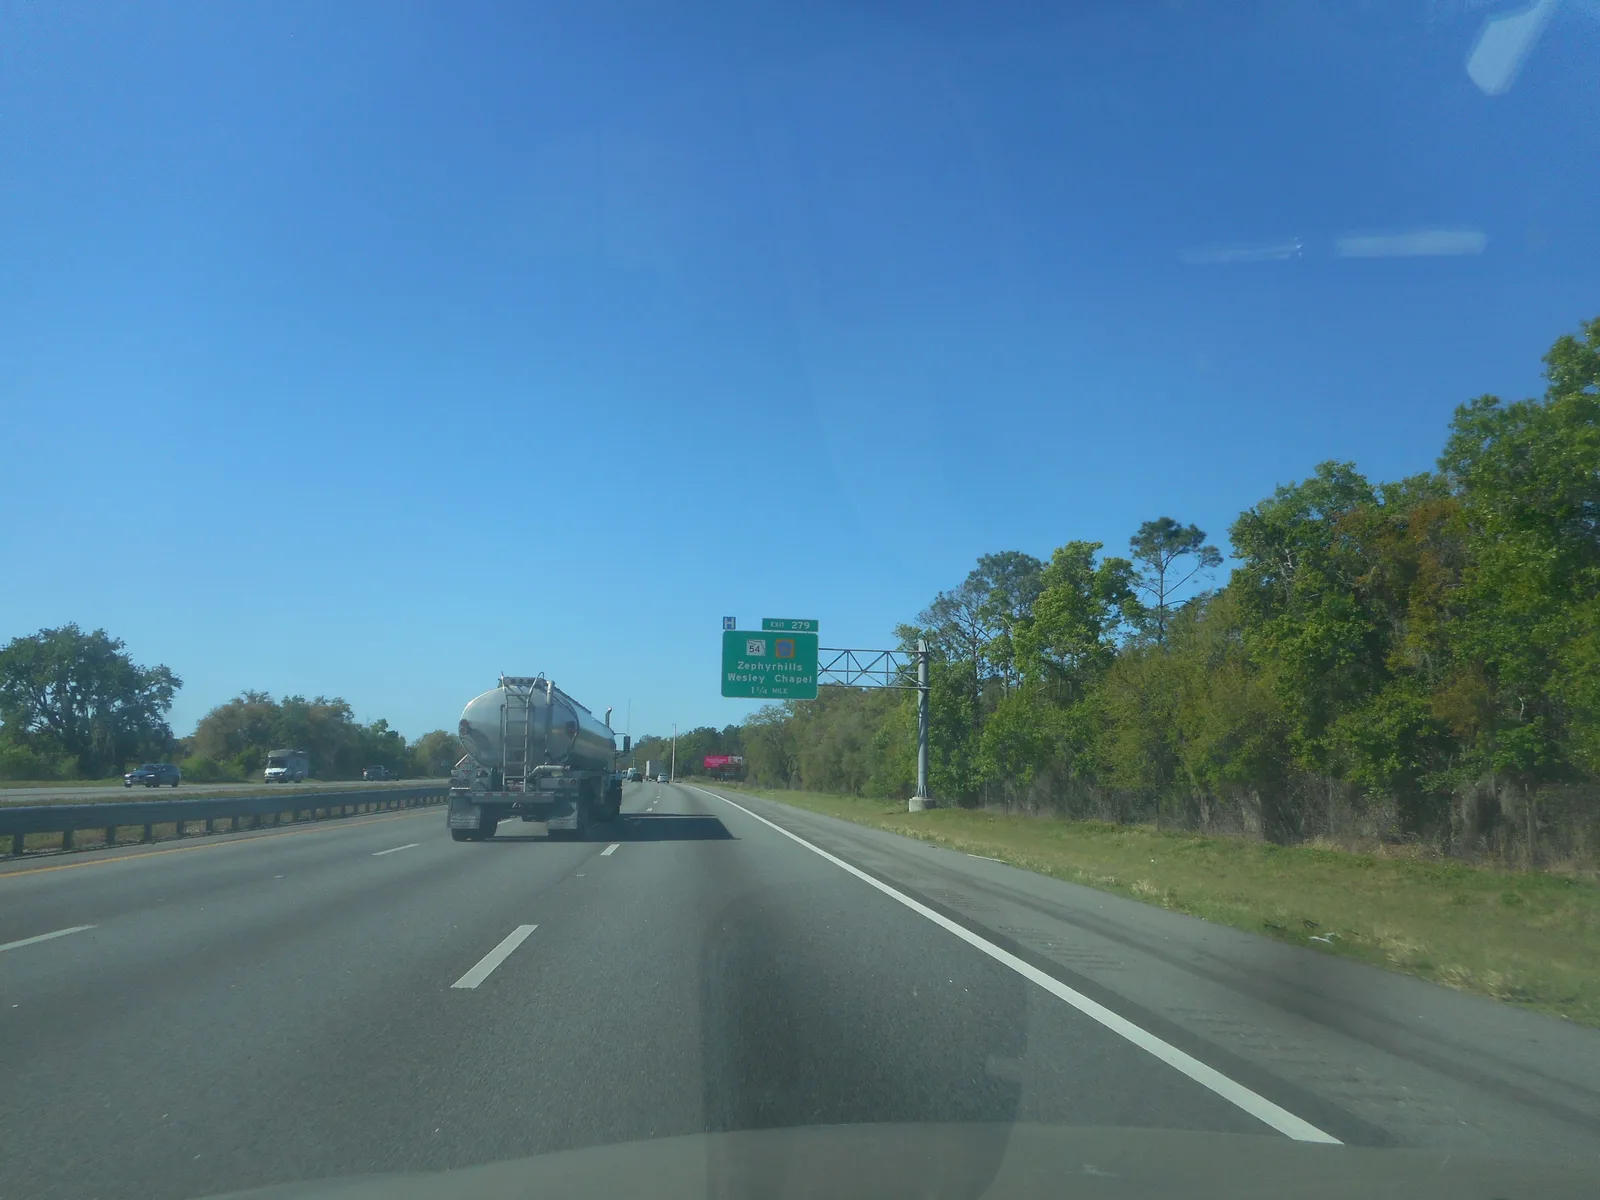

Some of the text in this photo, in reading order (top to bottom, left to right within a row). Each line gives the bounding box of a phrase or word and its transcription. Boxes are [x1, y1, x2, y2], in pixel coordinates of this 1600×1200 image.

[724, 618, 735, 630] H
[792, 621, 810, 629] 279
[737, 661, 803, 672] Zephyrhills
[727, 673, 812, 684] Wesley Chapel
